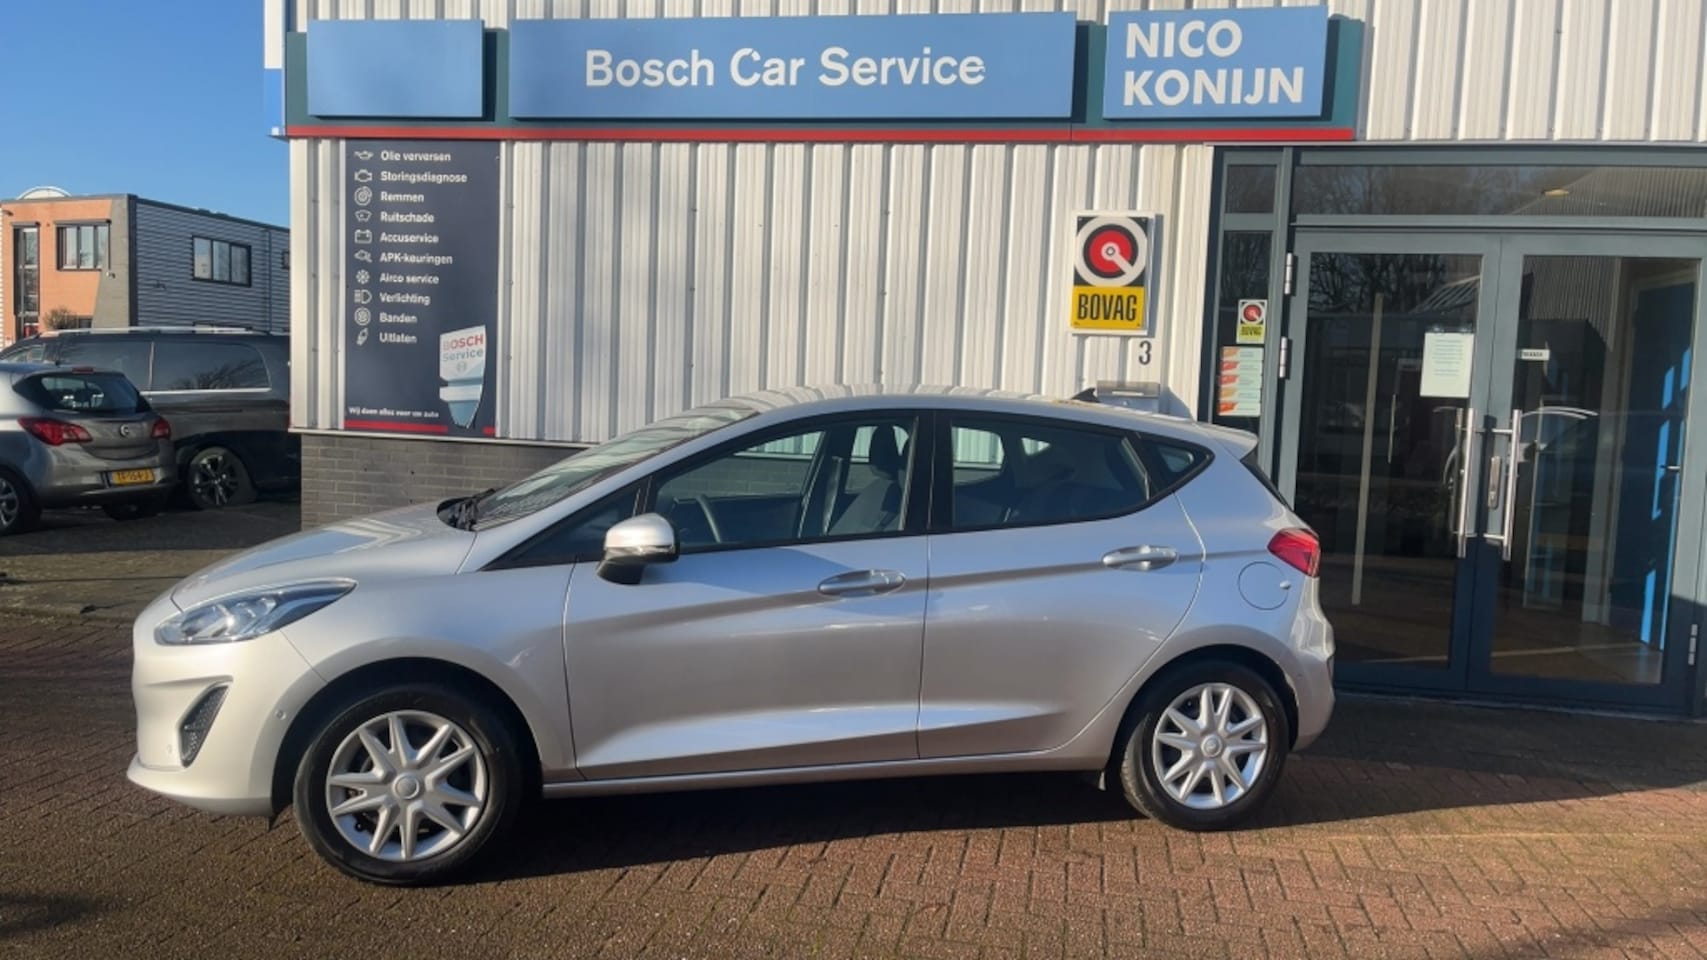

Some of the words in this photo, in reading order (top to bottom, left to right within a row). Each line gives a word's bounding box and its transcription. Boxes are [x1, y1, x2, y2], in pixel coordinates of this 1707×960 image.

[1126, 19, 1243, 58] NICO
[586, 49, 715, 87] Bosch
[730, 48, 805, 87] Car
[818, 46, 986, 86] Service
[1124, 67, 1304, 106] KONIJN
[380, 150, 401, 161] Olie
[403, 152, 451, 161] verversen
[380, 171, 468, 184] Storingsdiagnose
[380, 191, 424, 203] Remmen
[380, 211, 435, 223] Ruitschade
[380, 232, 439, 243] Accuservice
[380, 252, 453, 266] APK-keuringen
[379, 273, 404, 283] Airco
[406, 274, 439, 284] service
[379, 292, 431, 306] Verlichting
[1077, 293, 1138, 321] BOVAG
[379, 312, 417, 324] Banden
[379, 332, 417, 344] Uitlaten
[443, 334, 484, 351] BOSCH
[443, 348, 484, 361] Service
[1138, 340, 1152, 365] 3
